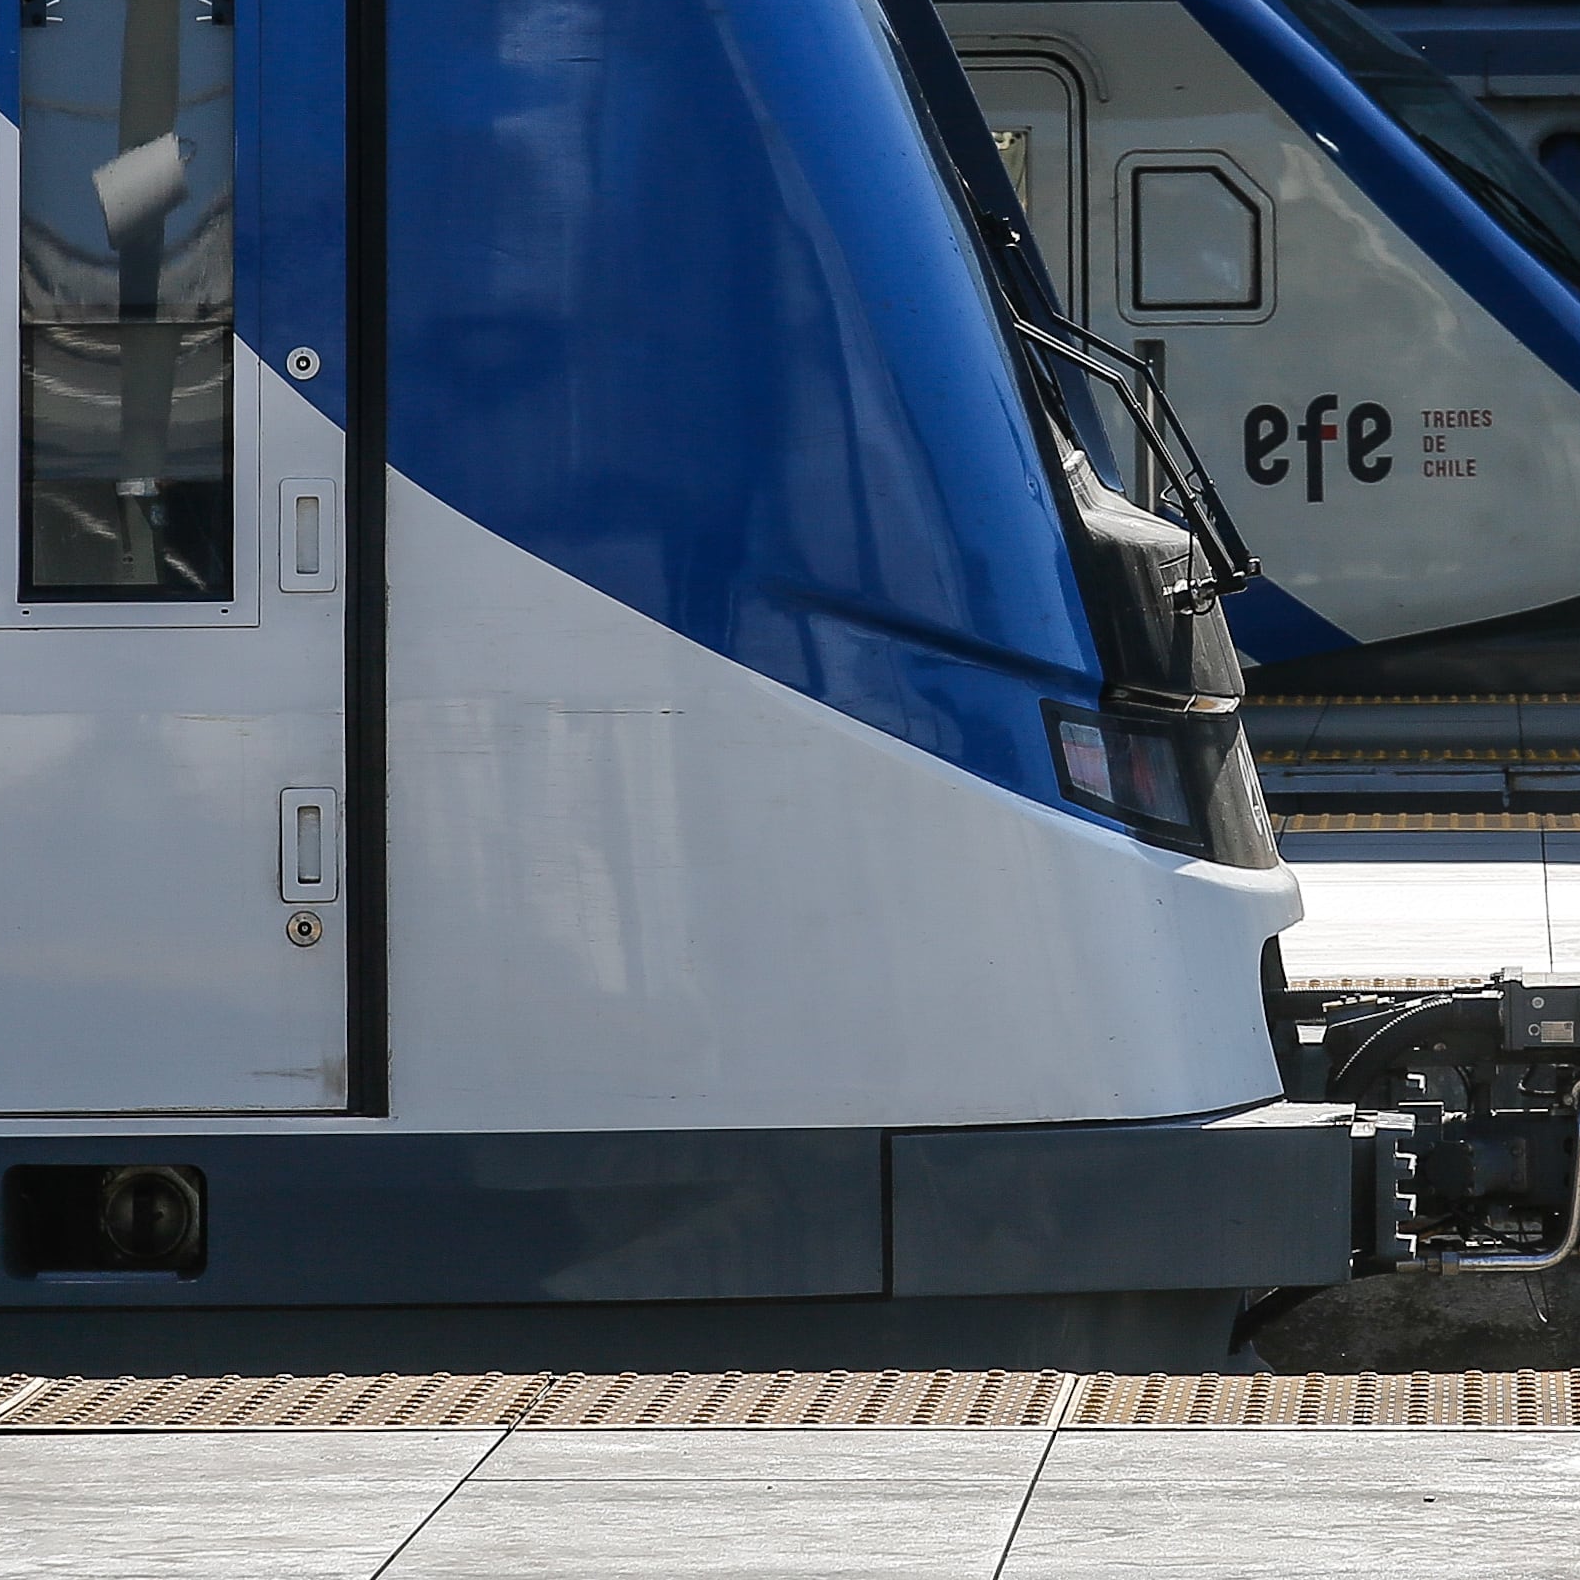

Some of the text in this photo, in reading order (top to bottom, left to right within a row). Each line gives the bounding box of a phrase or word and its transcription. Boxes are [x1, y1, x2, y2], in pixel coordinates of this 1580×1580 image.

[1243, 393, 1394, 504] efe
[1422, 434, 1447, 454] DE
[1422, 457, 1478, 479] CHILE
